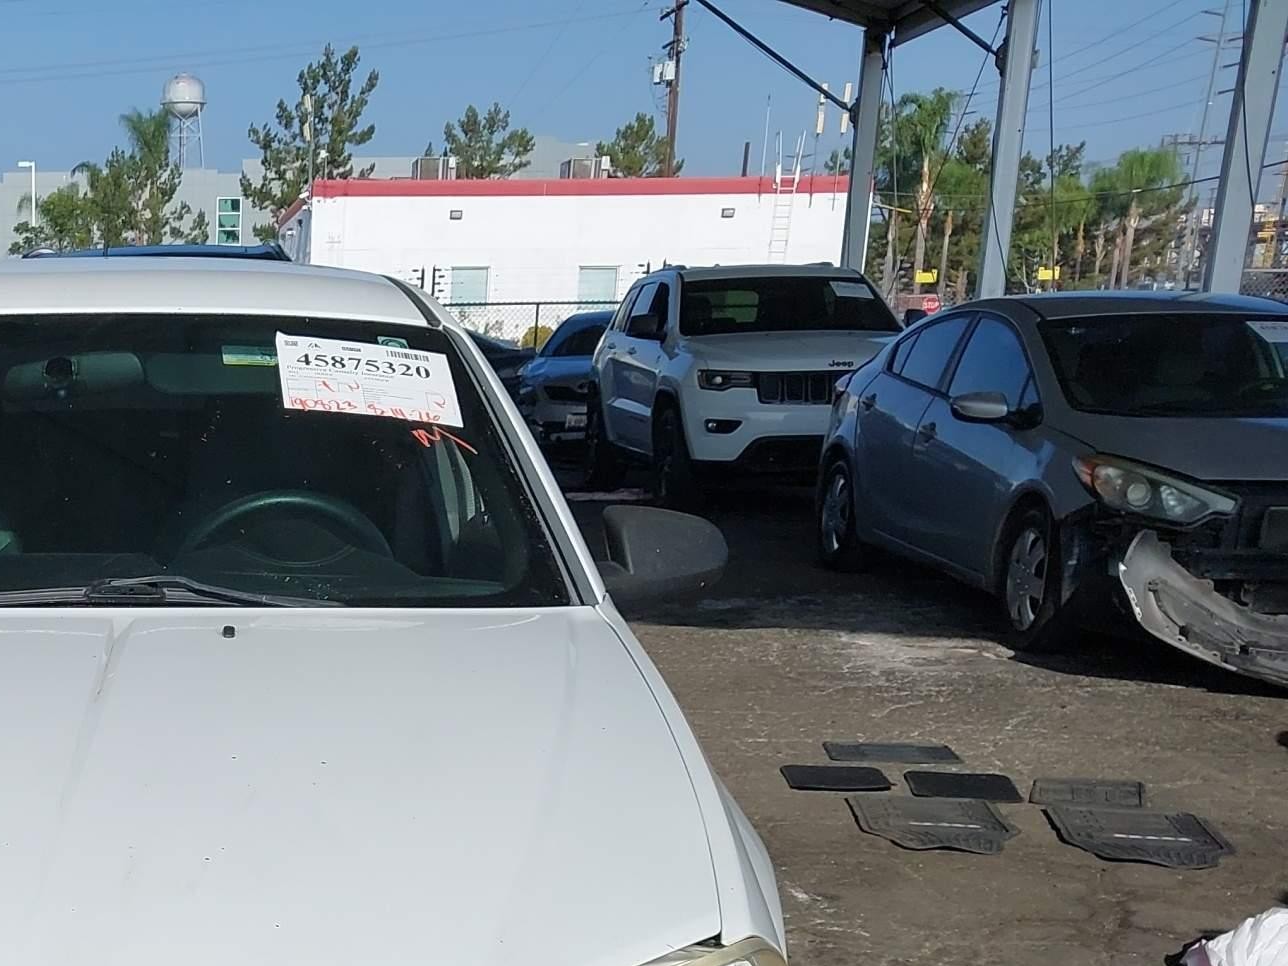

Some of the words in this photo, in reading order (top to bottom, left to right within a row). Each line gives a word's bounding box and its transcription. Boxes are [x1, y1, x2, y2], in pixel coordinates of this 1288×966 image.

[922, 301, 939, 309] STOP
[296, 353, 431, 379] 45875320
[828, 360, 854, 368] Jeep
